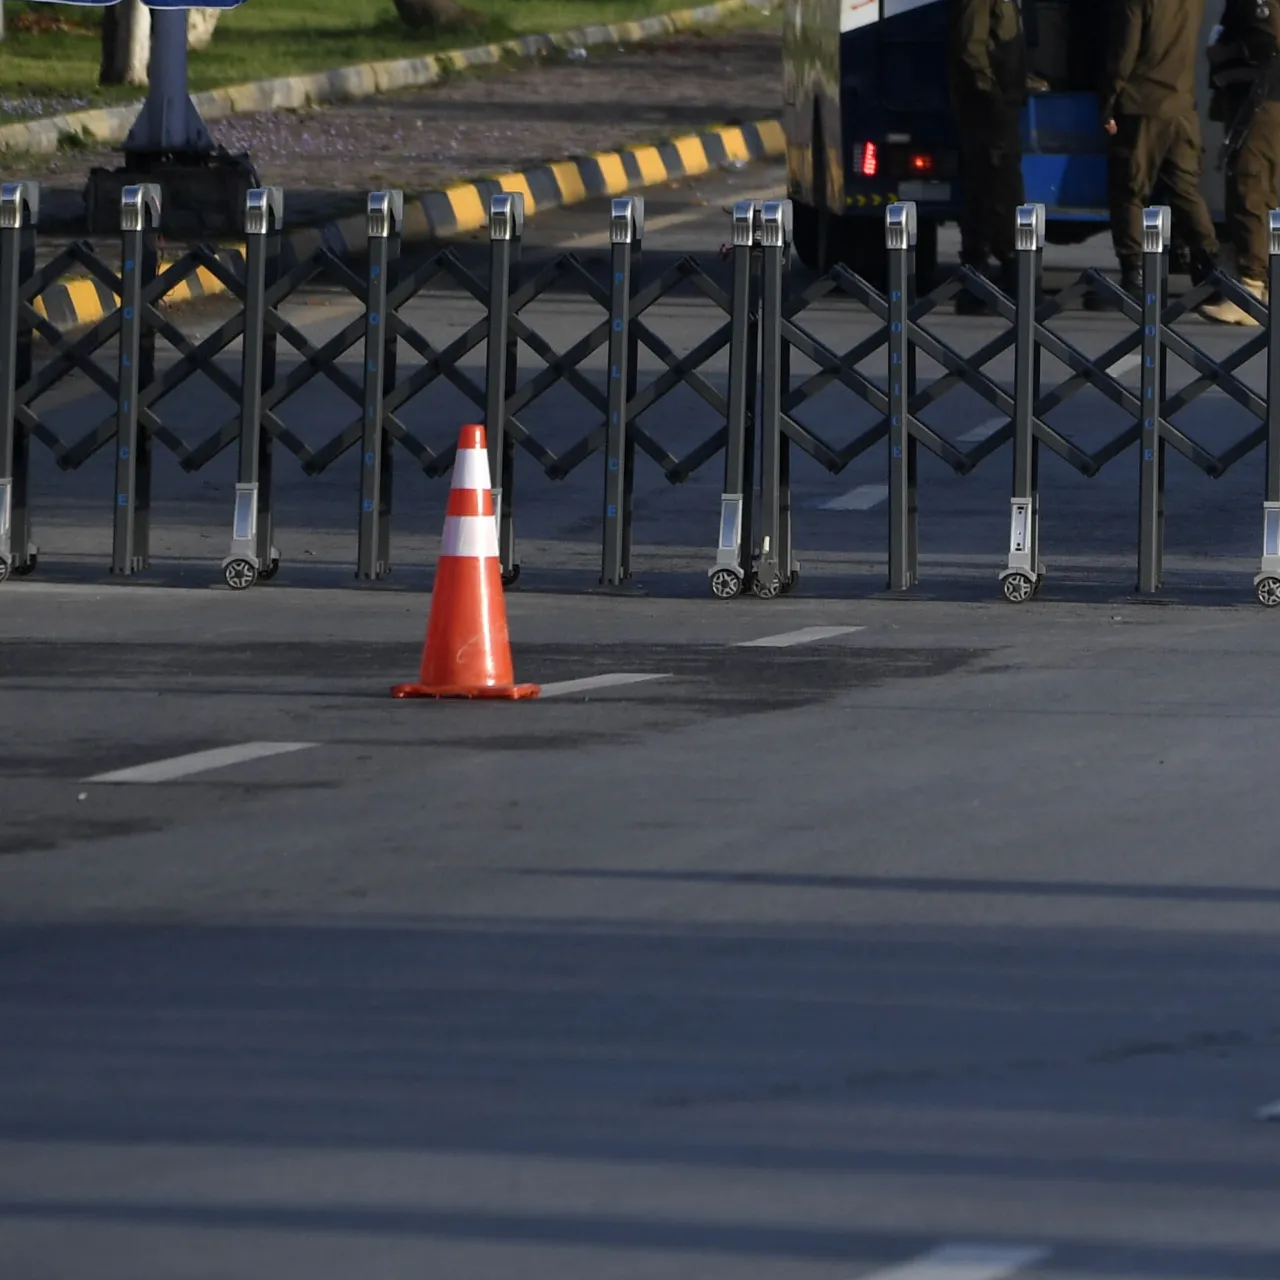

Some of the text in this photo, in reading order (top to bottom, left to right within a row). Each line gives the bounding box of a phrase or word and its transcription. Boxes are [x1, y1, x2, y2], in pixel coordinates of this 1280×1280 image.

[117, 257, 136, 507] POLICE
[361, 264, 381, 513] POLICE
[606, 270, 625, 518] POLICE
[889, 289, 903, 461] POLICE
[1143, 292, 1157, 462] POLICE
